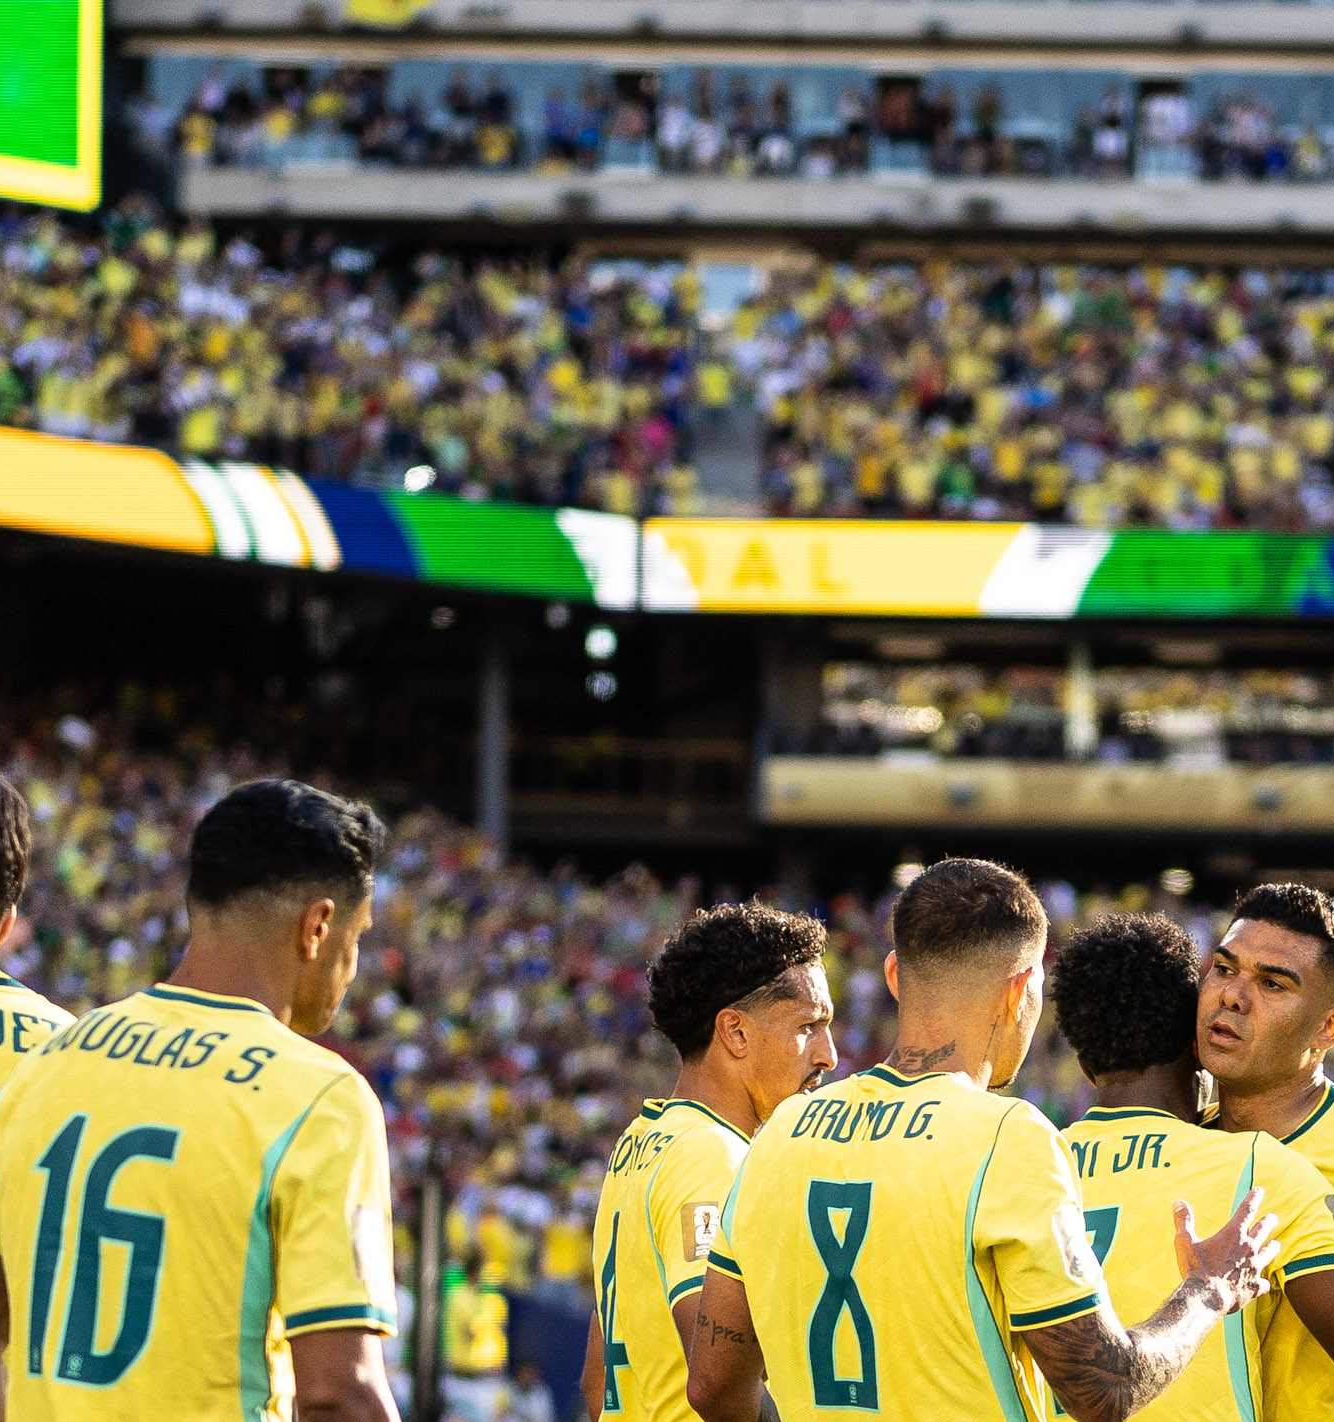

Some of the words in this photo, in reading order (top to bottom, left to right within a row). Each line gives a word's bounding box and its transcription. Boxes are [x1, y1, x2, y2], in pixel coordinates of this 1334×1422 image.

[223, 1046, 276, 1091] S.
[903, 1100, 942, 1140] G.
[1112, 1133, 1172, 1174] JR.
[28, 1111, 181, 1388] 16
[599, 1209, 631, 1414] 4
[807, 1177, 881, 1414] 8
